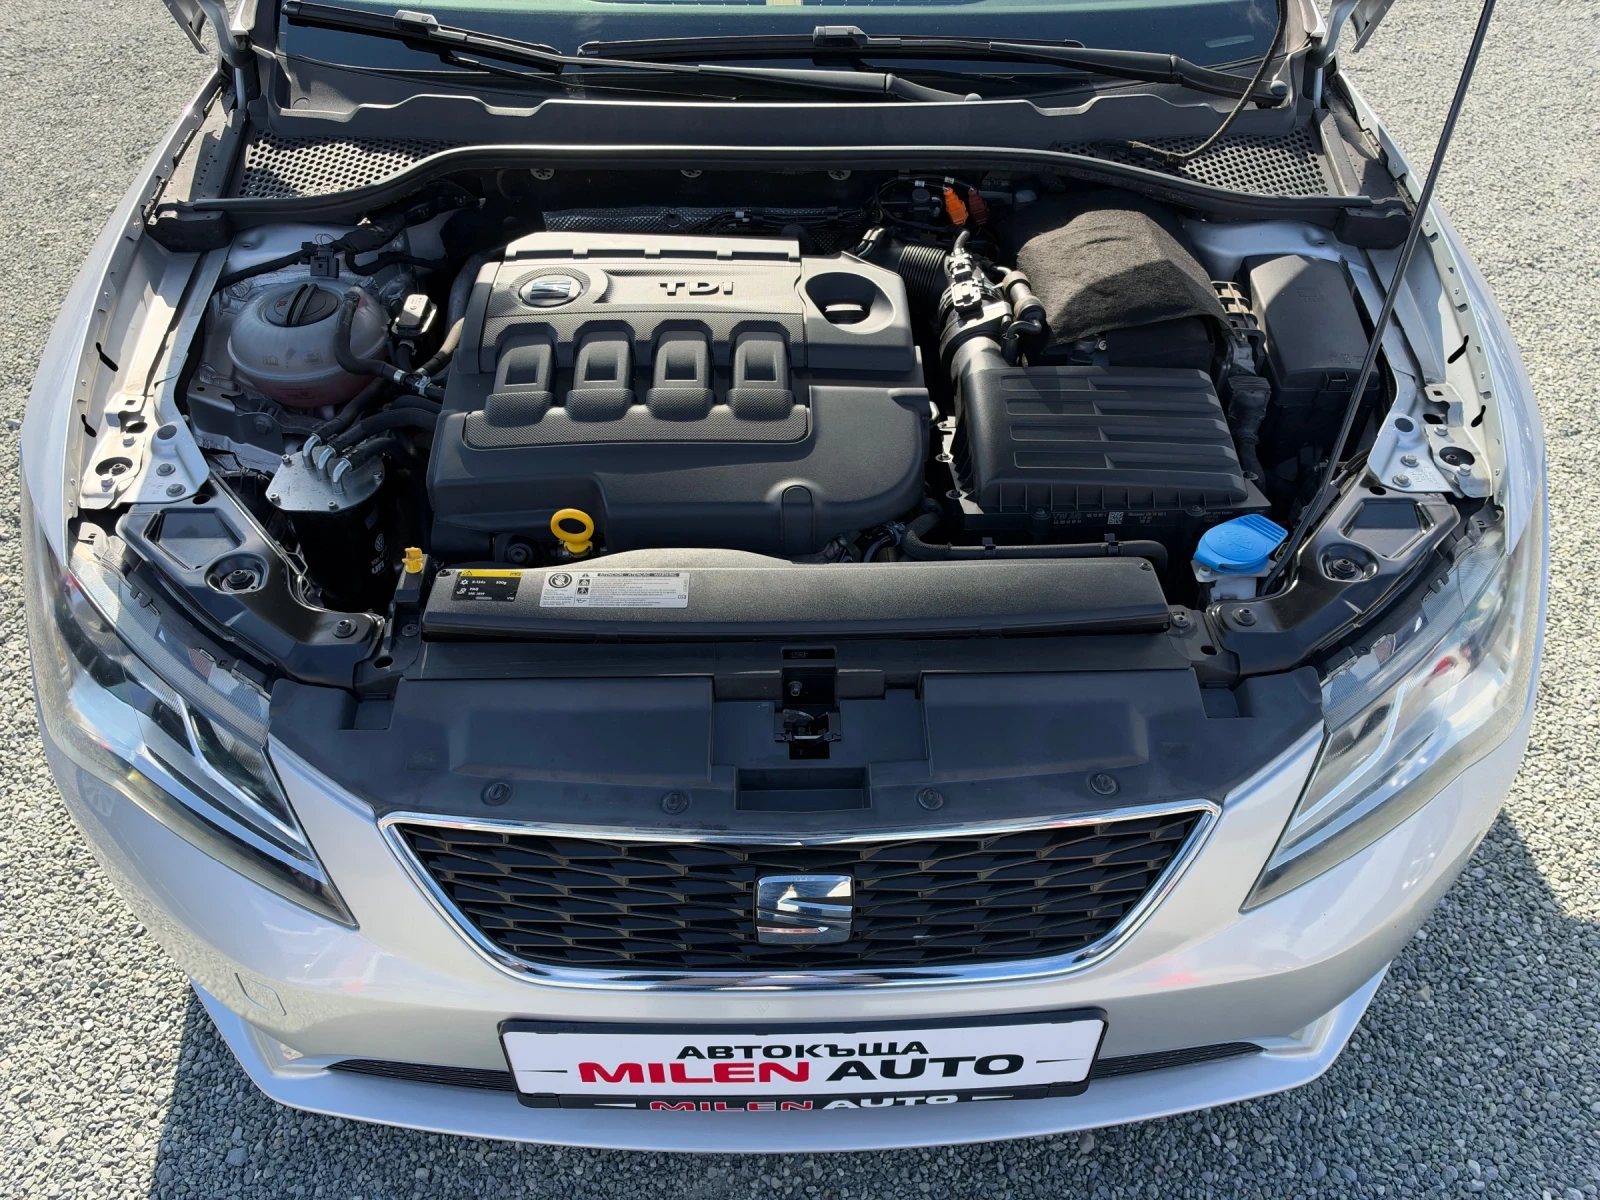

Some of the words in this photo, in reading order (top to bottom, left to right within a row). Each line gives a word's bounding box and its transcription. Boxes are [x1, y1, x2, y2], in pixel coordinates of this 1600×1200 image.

[676, 1041, 929, 1059] АВТОКЪША
[578, 1062, 809, 1083] MILEN
[825, 1054, 1024, 1081] AUTO
[650, 1100, 813, 1111] MILEN
[822, 1095, 958, 1110] AUTO
